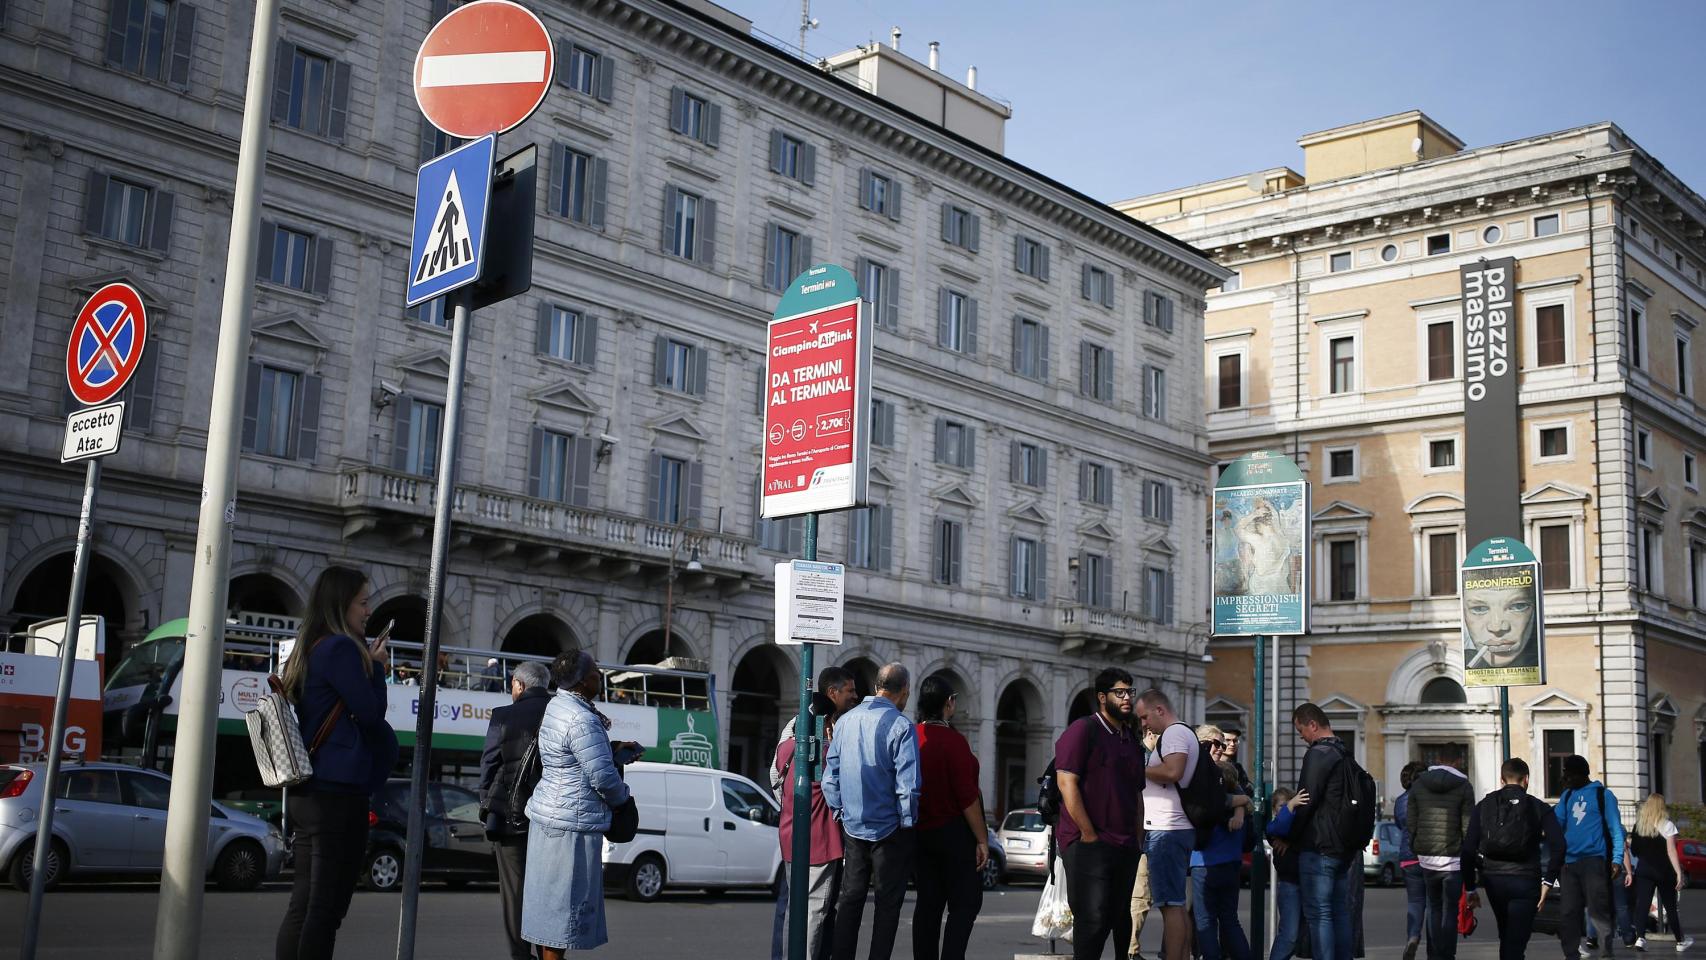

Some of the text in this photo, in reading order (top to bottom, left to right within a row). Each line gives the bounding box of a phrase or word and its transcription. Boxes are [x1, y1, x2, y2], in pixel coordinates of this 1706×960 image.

[801, 280, 824, 294] Termini
[1484, 267, 1512, 377] palazzo
[1465, 270, 1486, 401] massimo
[772, 359, 842, 388] DA TERMINI
[770, 376, 851, 406] AL TERMINAL
[72, 412, 114, 433] eccetto
[821, 417, 843, 431] 2,70€
[76, 437, 103, 453] Atac
[1488, 547, 1509, 555] Termini
[1216, 594, 1299, 606] IMPRESSIONISTI
[1235, 603, 1279, 613] SEGRETI
[1506, 667, 1537, 675] BRAMANTE
[411, 699, 492, 720] EjoyBus
[18, 723, 86, 753] BG
